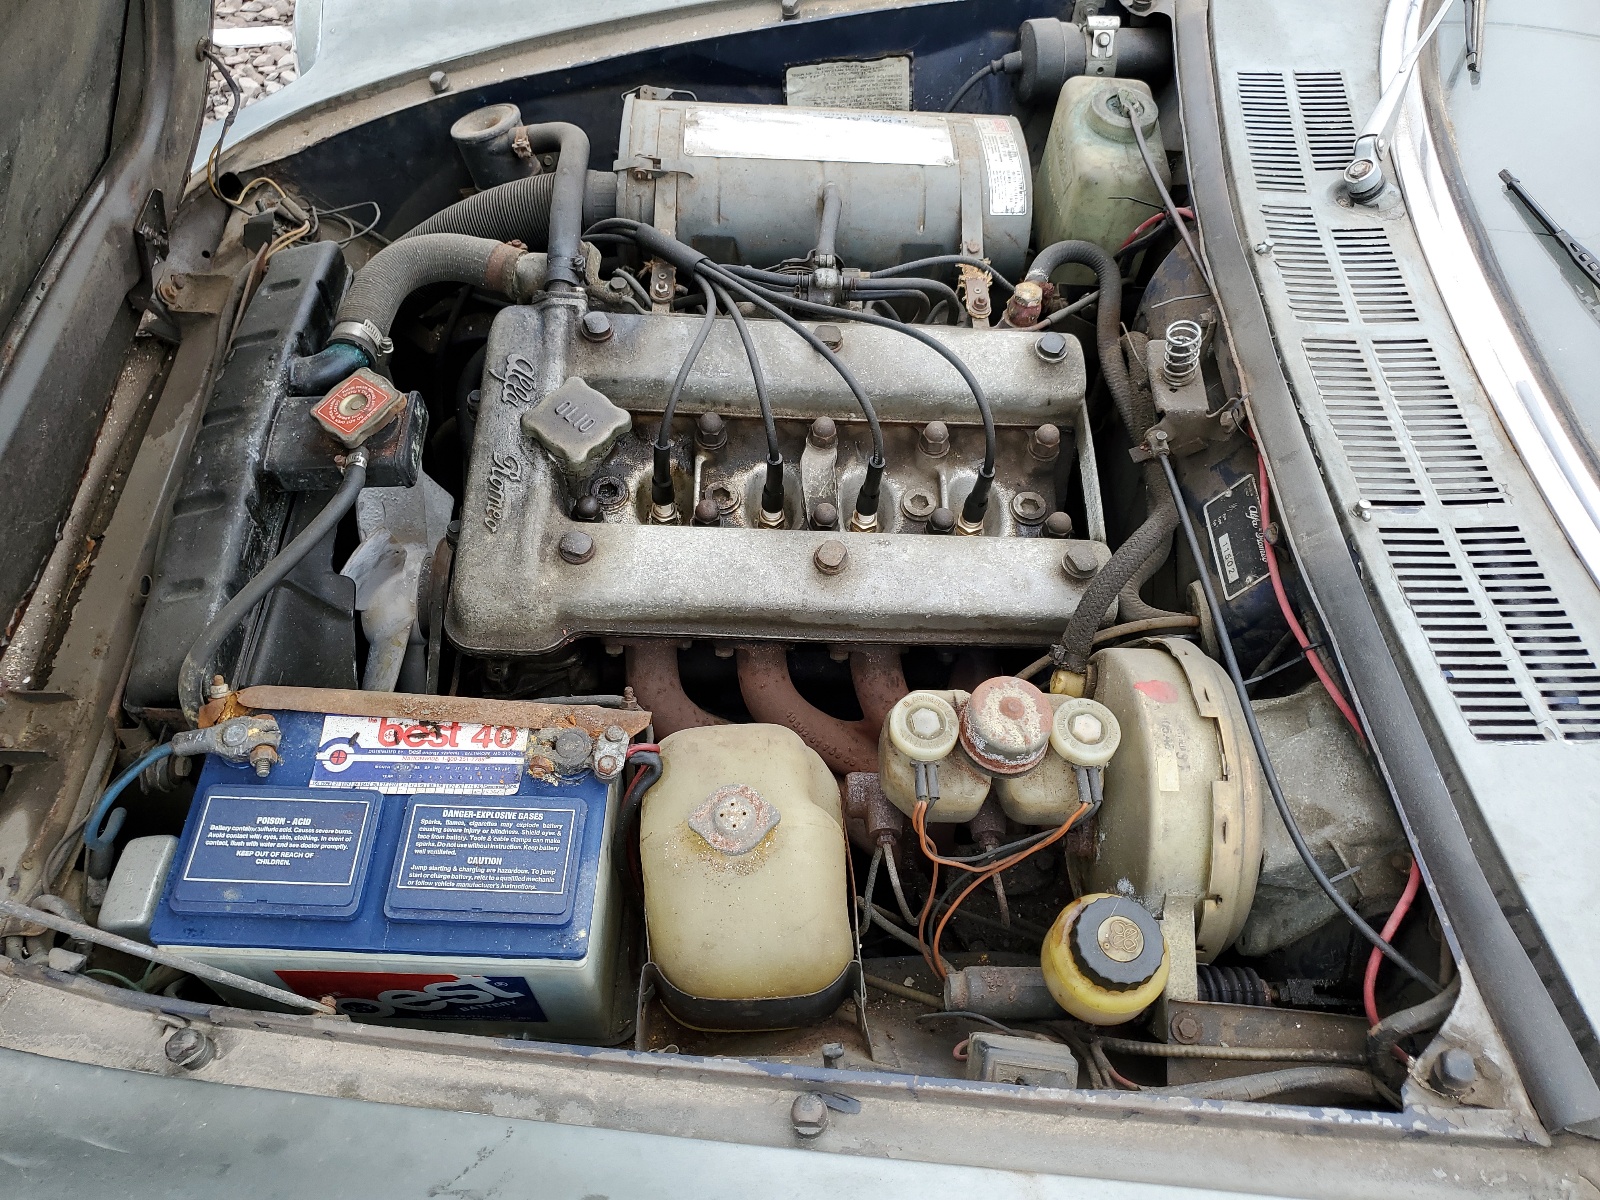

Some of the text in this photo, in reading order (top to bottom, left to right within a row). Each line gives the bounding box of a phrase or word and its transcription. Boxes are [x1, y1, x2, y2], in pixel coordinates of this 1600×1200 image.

[488, 353, 535, 407] Alfa
[554, 401, 597, 433] OLIO
[378, 717, 462, 747] best
[471, 725, 518, 748] 40
[256, 816, 286, 825] POISON
[292, 818, 311, 826] ACID
[442, 809, 544, 821] DANGER-EXPLOSIVE GASES
[467, 856, 502, 865] CAUTION
[460, 1000, 517, 1013] BATTERY
